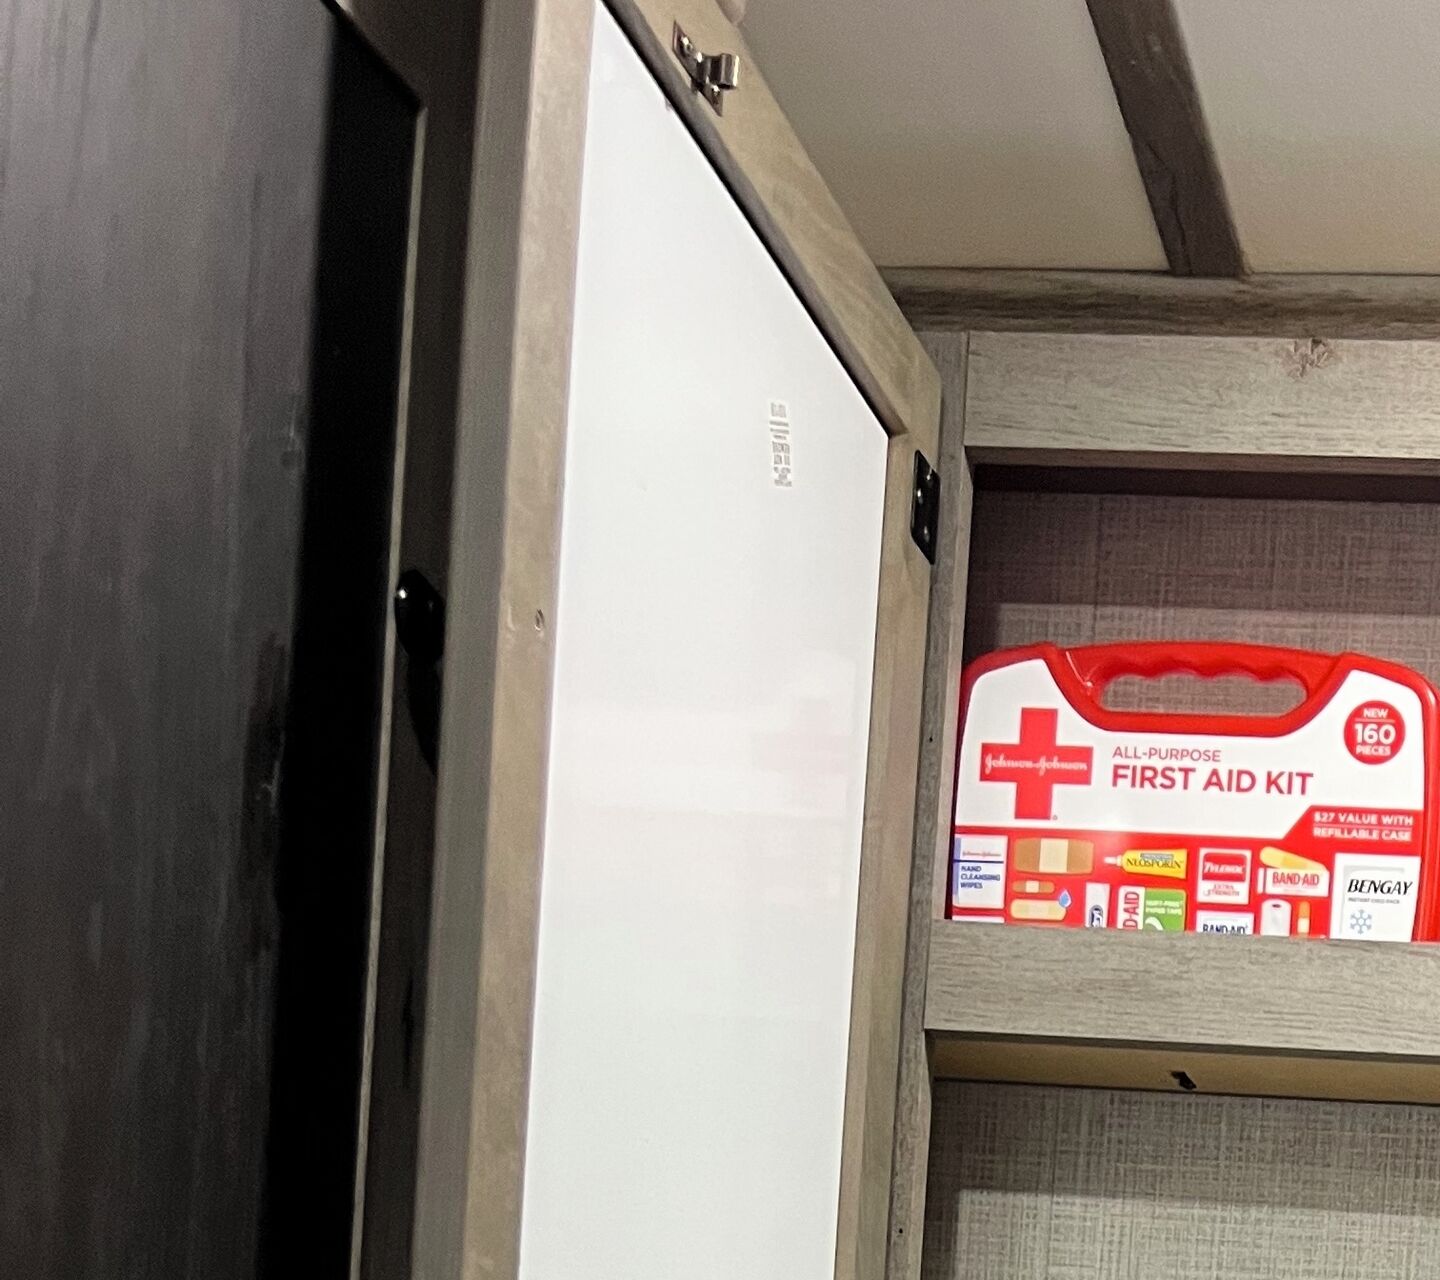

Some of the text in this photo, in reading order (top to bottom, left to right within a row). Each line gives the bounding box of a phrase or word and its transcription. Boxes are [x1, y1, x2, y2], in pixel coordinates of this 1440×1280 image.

[1363, 708, 1389, 718] NEW
[1354, 723, 1397, 745] 160
[1112, 746, 1222, 763] ALL-PURPOSE
[1355, 745, 1392, 756] PIECES
[1112, 764, 1314, 796] FIRST AID KIT
[1314, 811, 1414, 827] $27 VALUE WITH
[1313, 827, 1413, 842] REFILLABLE CASE
[1347, 879, 1413, 896] BENGAY
